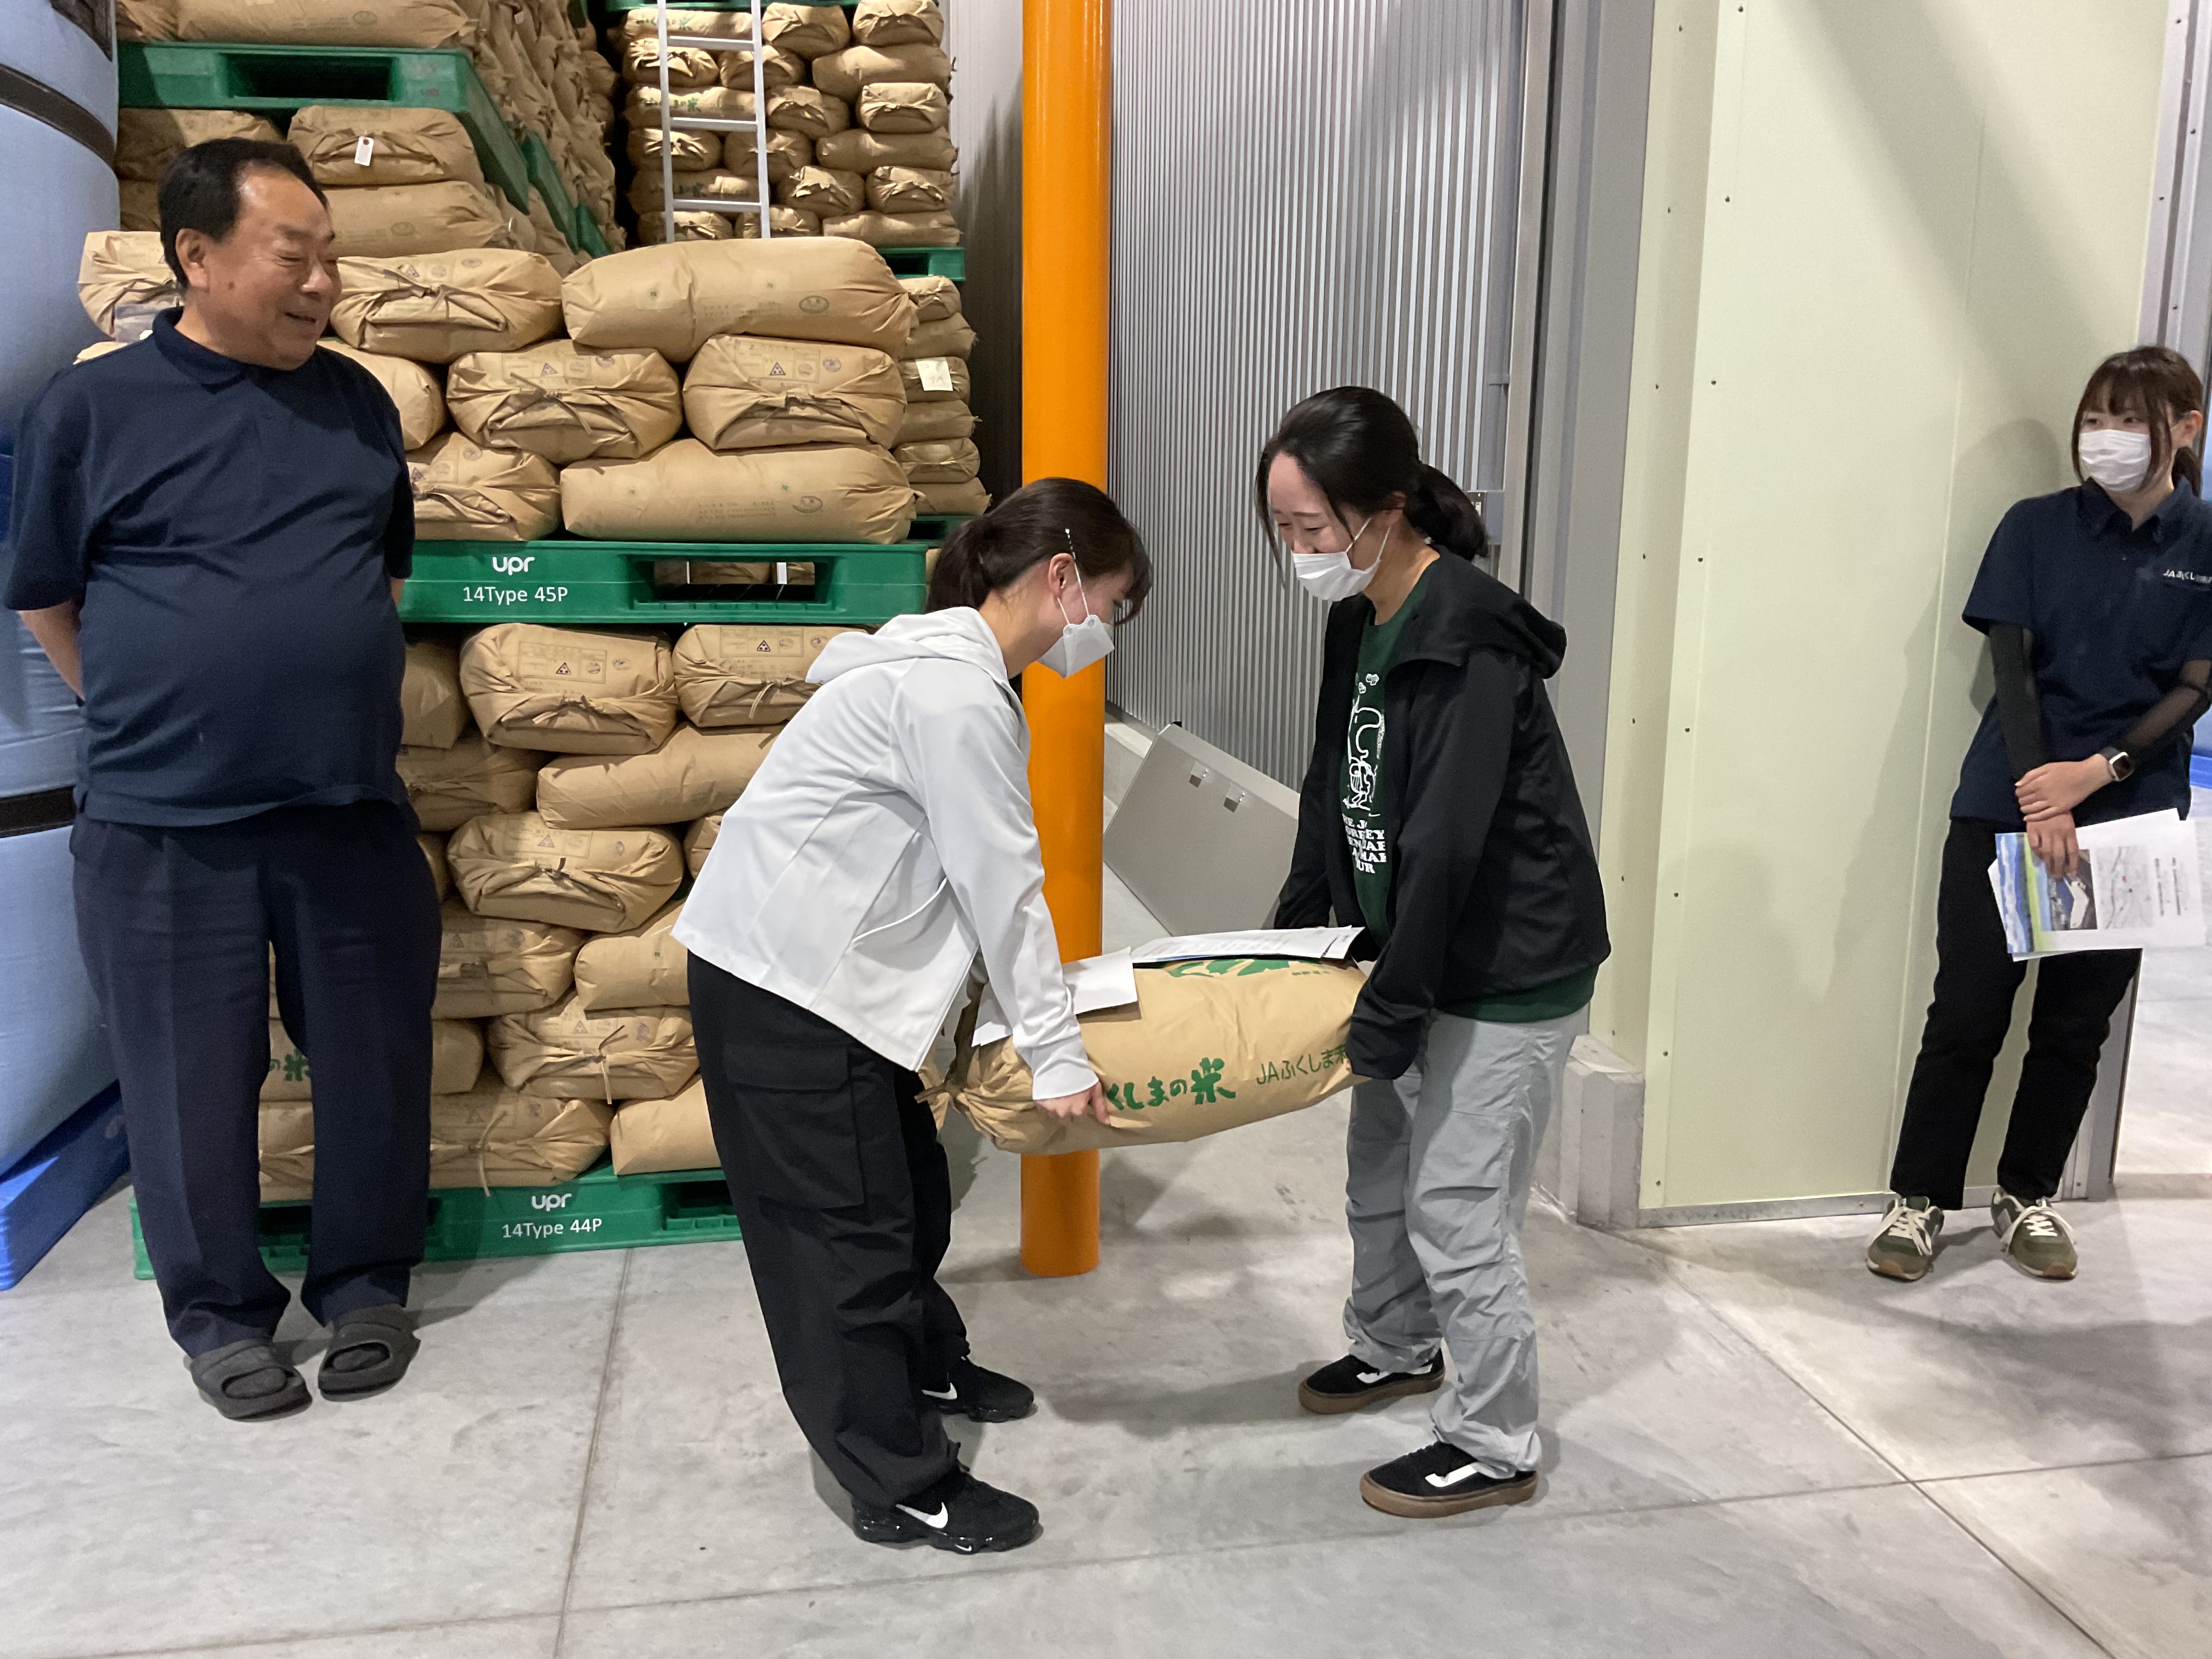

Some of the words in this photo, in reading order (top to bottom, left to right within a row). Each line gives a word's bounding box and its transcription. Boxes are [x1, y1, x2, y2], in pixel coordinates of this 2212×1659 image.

[492, 556, 535, 575] upr
[463, 586, 528, 606] 14Type
[534, 586, 568, 602] 45P
[532, 1193, 572, 1212] upr
[501, 1222, 564, 1239] 14Type
[569, 1218, 602, 1233] 44P
